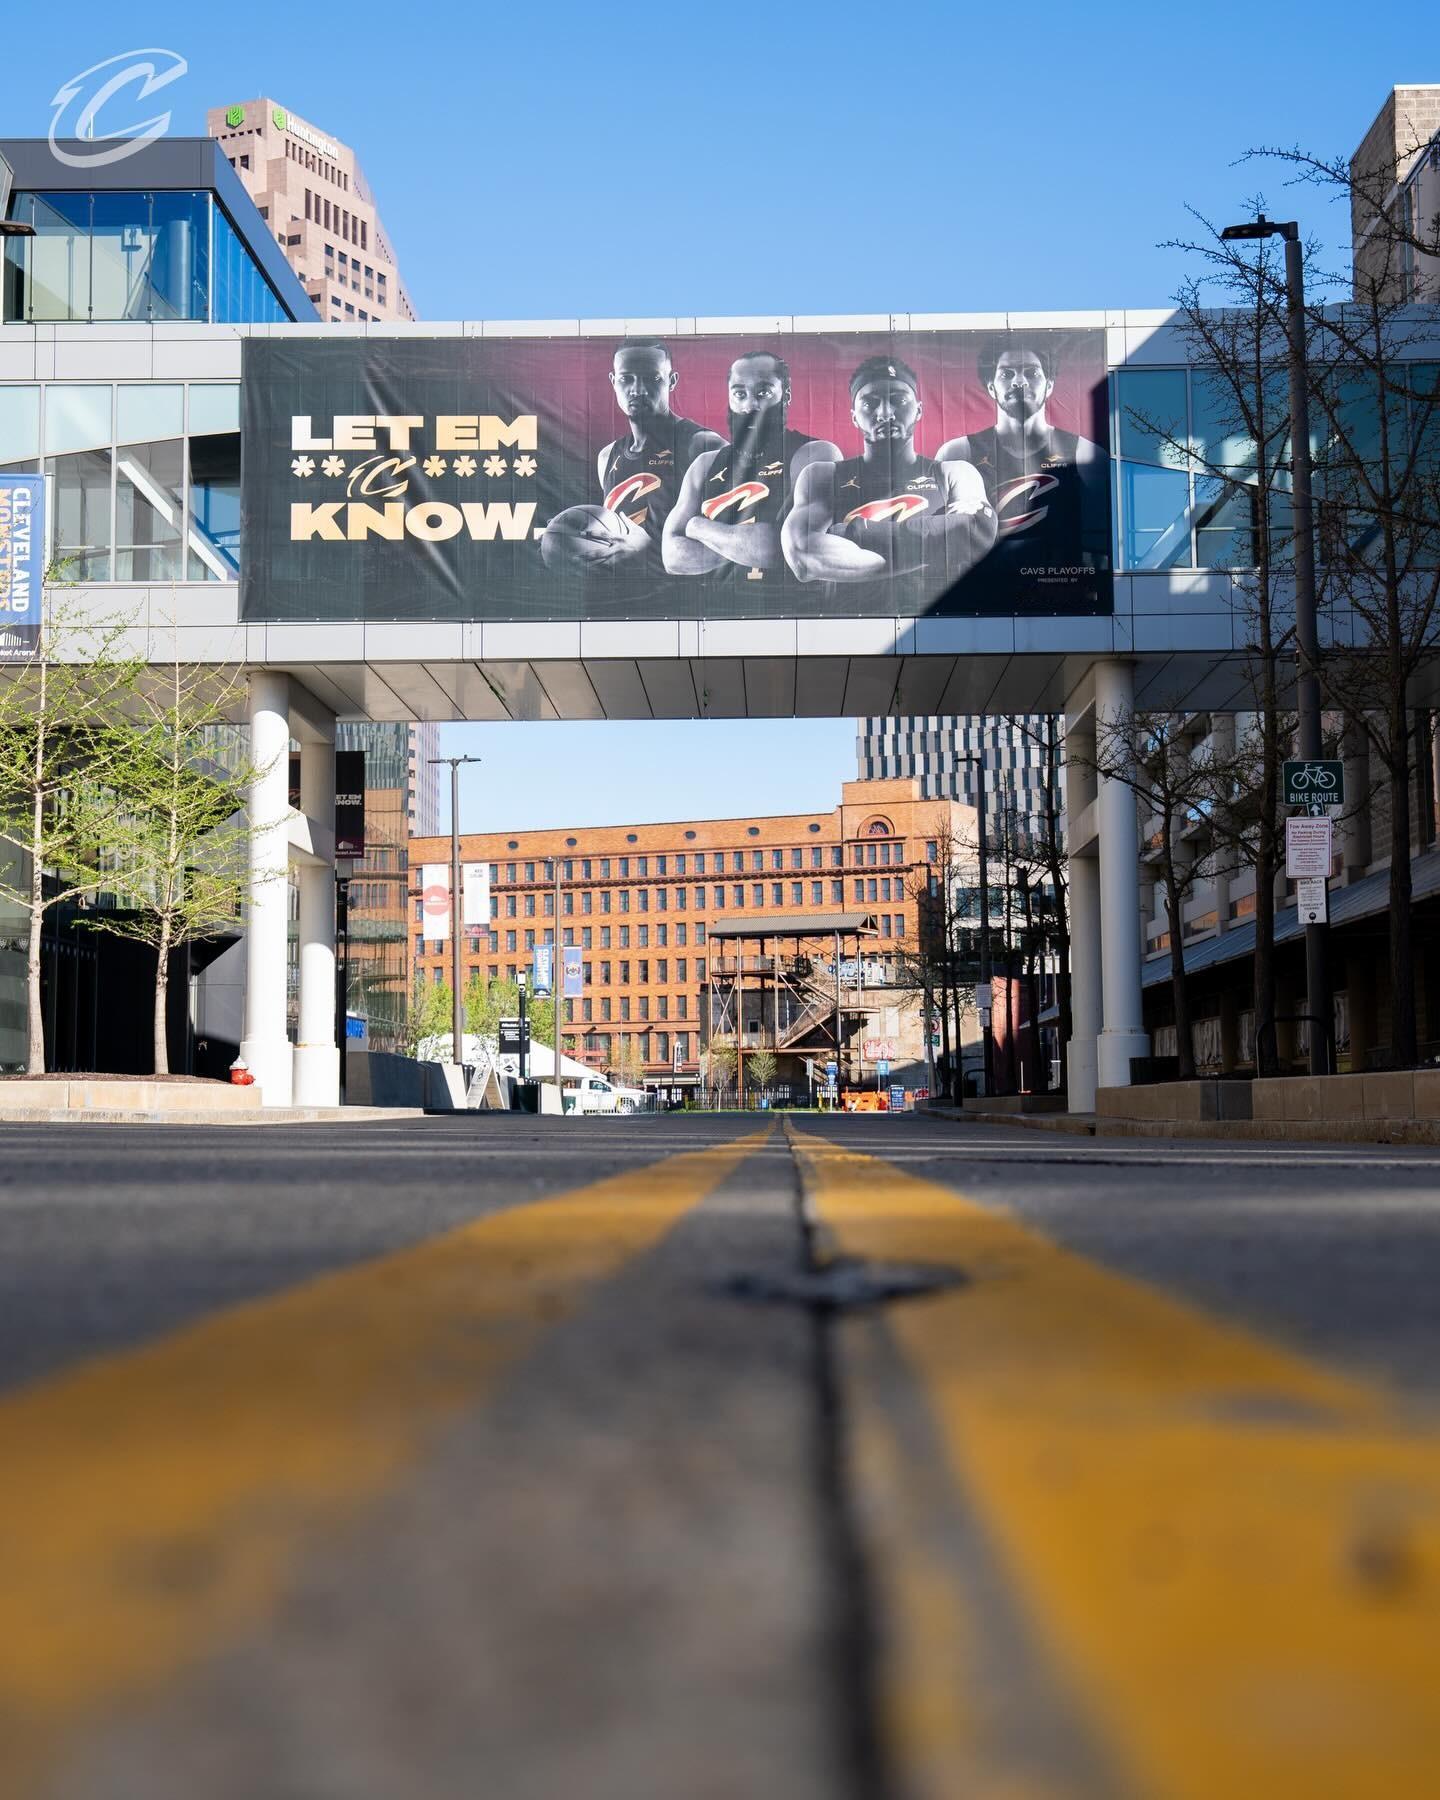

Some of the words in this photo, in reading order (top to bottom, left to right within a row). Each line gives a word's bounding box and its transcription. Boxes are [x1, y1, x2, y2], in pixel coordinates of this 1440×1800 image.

[286, 112, 338, 159] Huntington
[291, 415, 424, 451] LET
[436, 415, 538, 451] EM
[290, 501, 547, 542] KNOW.
[12, 487, 31, 613] CLEVELAND
[1020, 567, 1046, 576] CAVS
[1047, 566, 1096, 575] PLAYOFFS
[1289, 792, 1310, 803] BIKE
[1311, 792, 1339, 803] ROUTE
